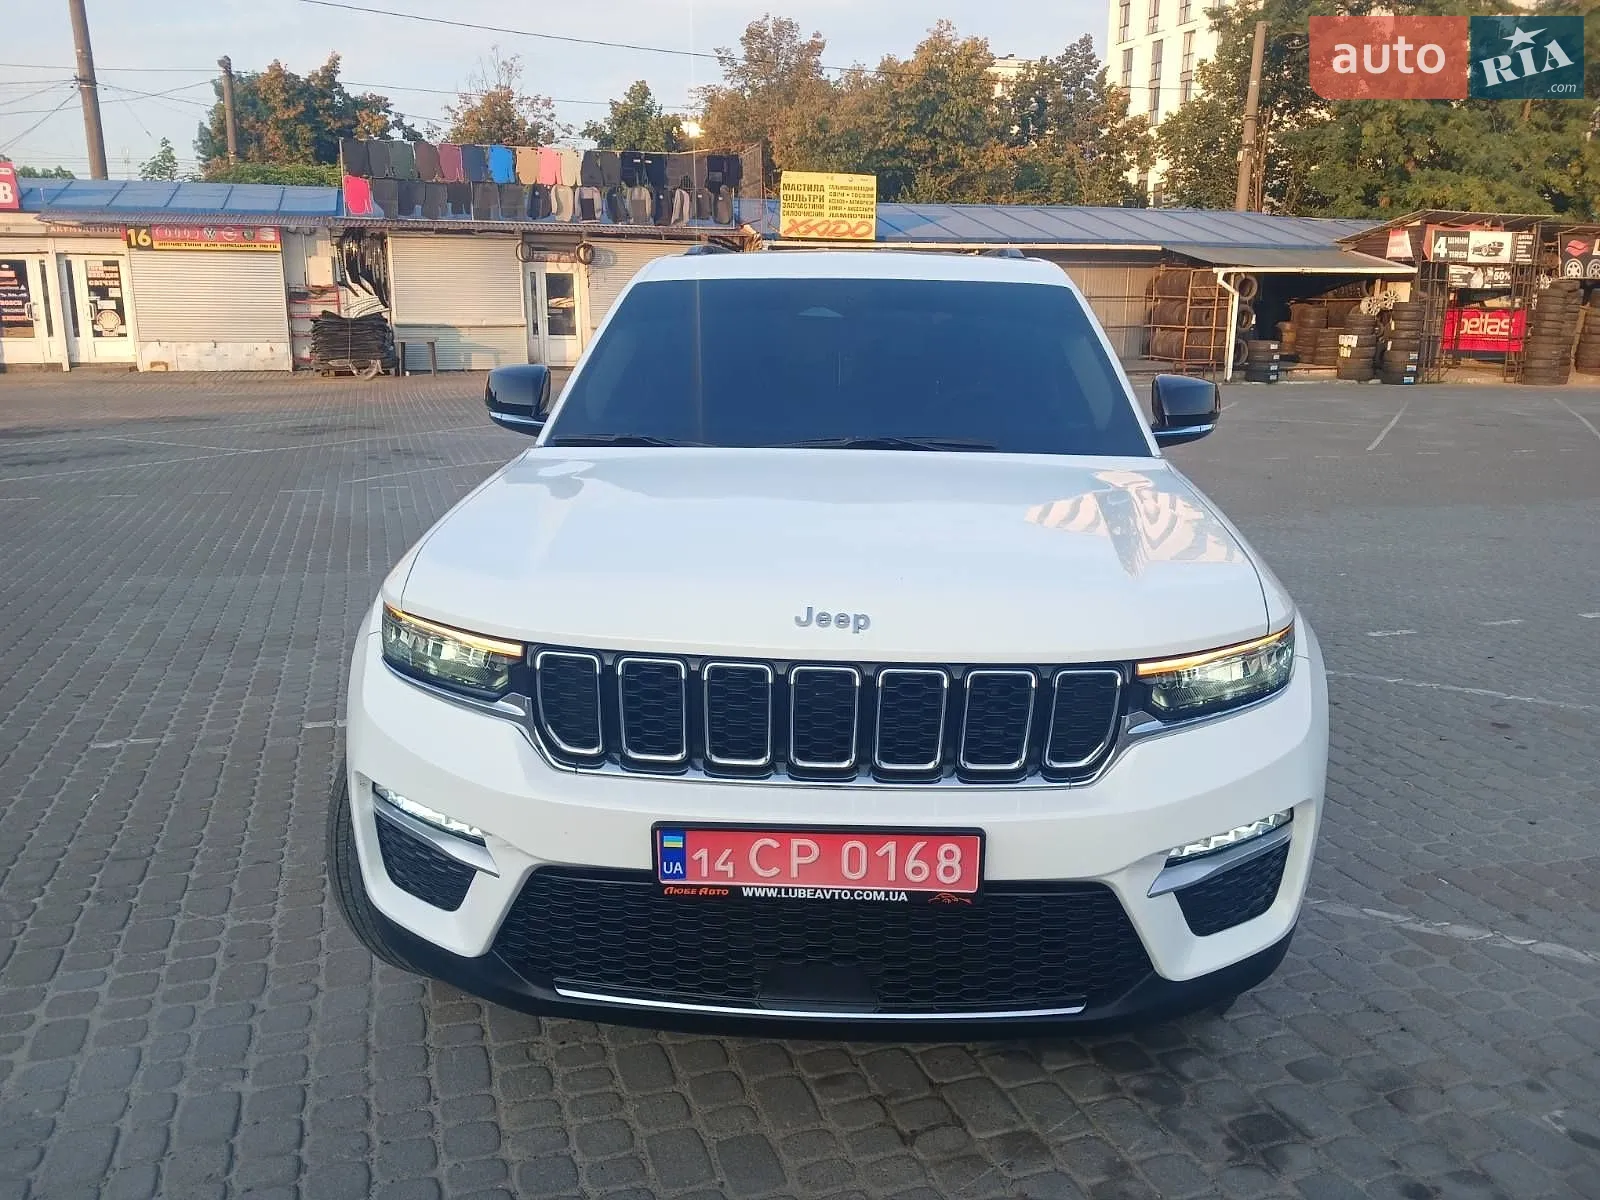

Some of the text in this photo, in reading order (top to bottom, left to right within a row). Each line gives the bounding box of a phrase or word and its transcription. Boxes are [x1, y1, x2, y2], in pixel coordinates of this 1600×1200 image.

[782, 183, 825, 192] МАСТИЛА
[782, 193, 825, 203] ФІЛЬТРИ
[127, 227, 151, 247] 16
[1434, 236, 1448, 258] 4
[794, 606, 871, 634] Jeep
[663, 861, 684, 875] UA
[691, 837, 963, 885] 14 CP 0168
[741, 885, 909, 903] WWW.LUBEAVTO.COM.UA
